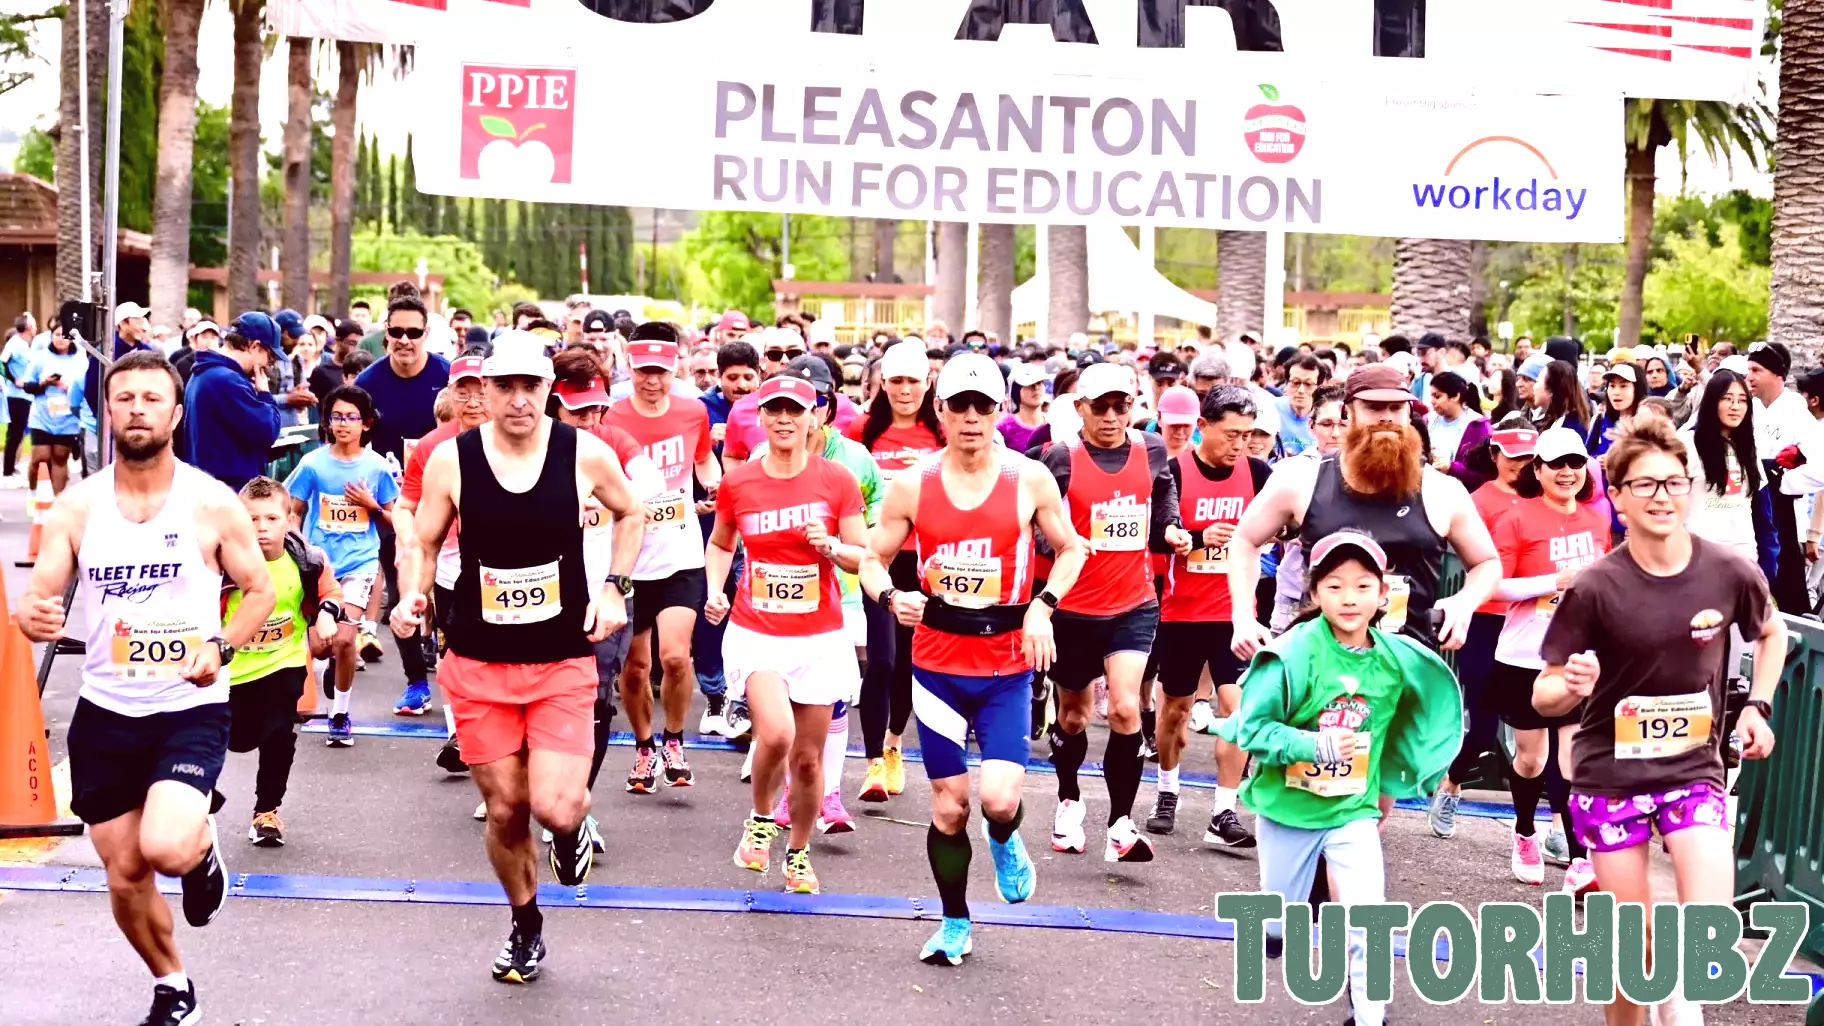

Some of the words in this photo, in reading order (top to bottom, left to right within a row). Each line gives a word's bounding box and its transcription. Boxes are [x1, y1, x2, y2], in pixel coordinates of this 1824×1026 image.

[468, 72, 569, 110] PPIE
[714, 80, 1197, 157] PLEASANTON
[713, 153, 832, 206] RUN
[851, 161, 968, 213] FOR
[986, 167, 1323, 223] EDUCATION
[1412, 176, 1587, 221] workday
[330, 509, 358, 522] 104
[653, 506, 676, 522] 89
[1195, 496, 1244, 521] BURN
[1103, 521, 1140, 538] 488
[1550, 531, 1595, 561] BURN
[88, 565, 136, 581] FLEET
[139, 562, 183, 579] FEET
[94, 581, 172, 606] Racing
[766, 582, 805, 600] 162
[939, 574, 985, 594] 467
[495, 587, 546, 609] 499
[128, 639, 187, 663] 209
[1637, 716, 1690, 740] 192
[171, 763, 205, 778] HOKA
[1304, 757, 1353, 778] 345
